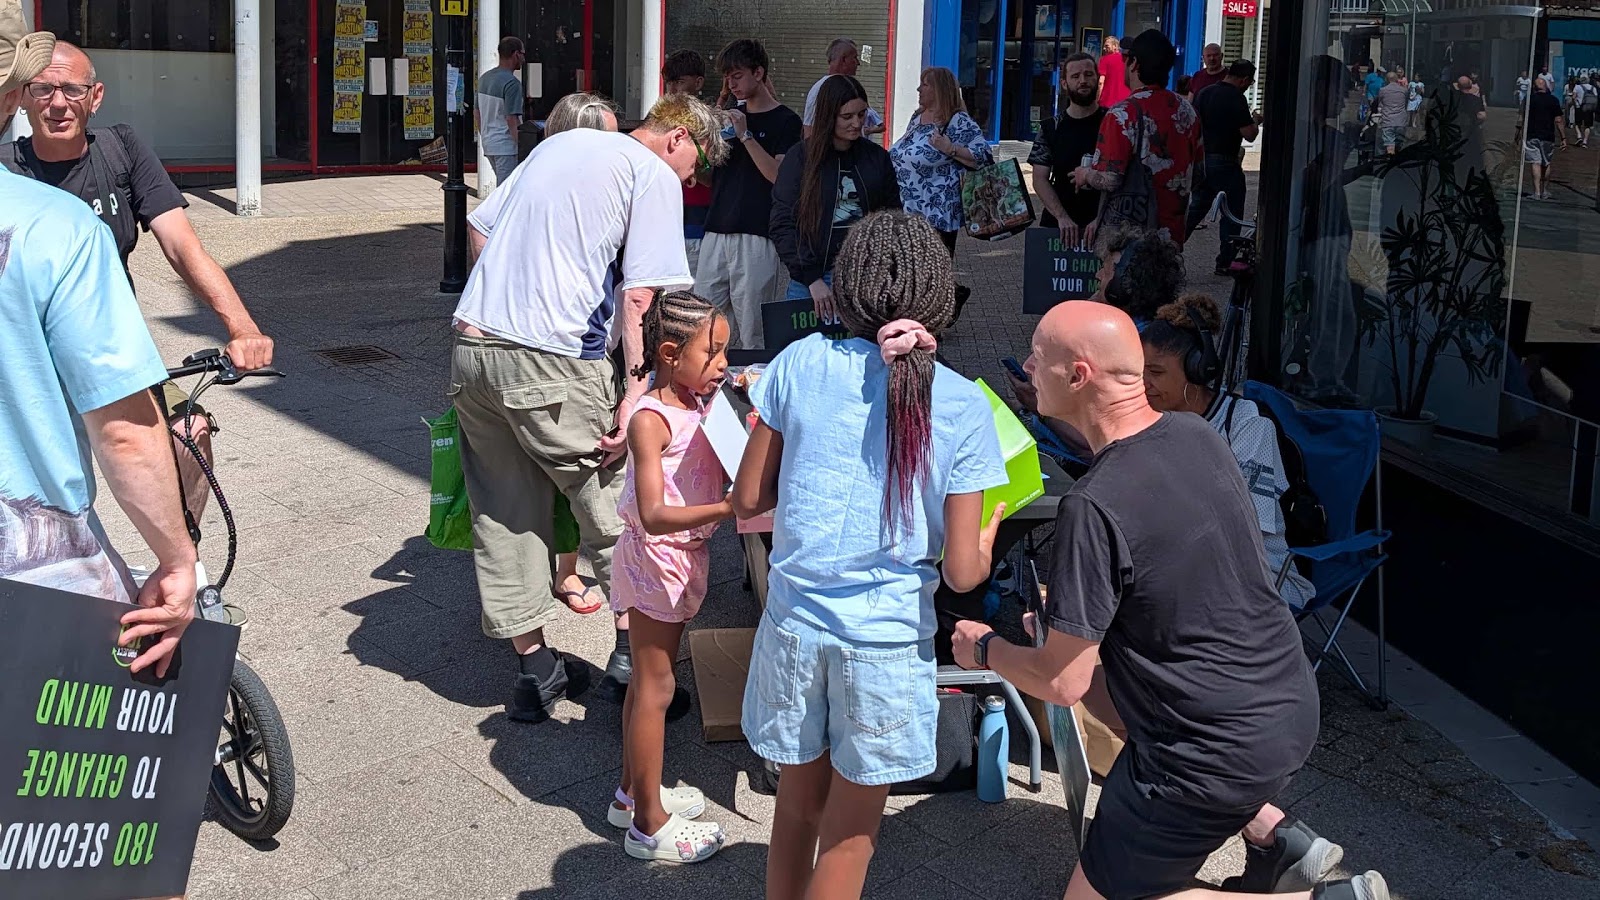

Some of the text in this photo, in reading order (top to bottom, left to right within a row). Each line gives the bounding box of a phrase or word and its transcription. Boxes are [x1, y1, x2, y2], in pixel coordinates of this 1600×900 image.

[1228, 2, 1247, 13] SALE
[1053, 258, 1103, 273] TO CHAN
[1052, 278, 1083, 292] YOUR
[791, 310, 818, 330] 180
[35, 678, 177, 735] YOUR MIND
[16, 749, 161, 799] TO CHANGE
[0, 822, 159, 871] 180 SECOND
